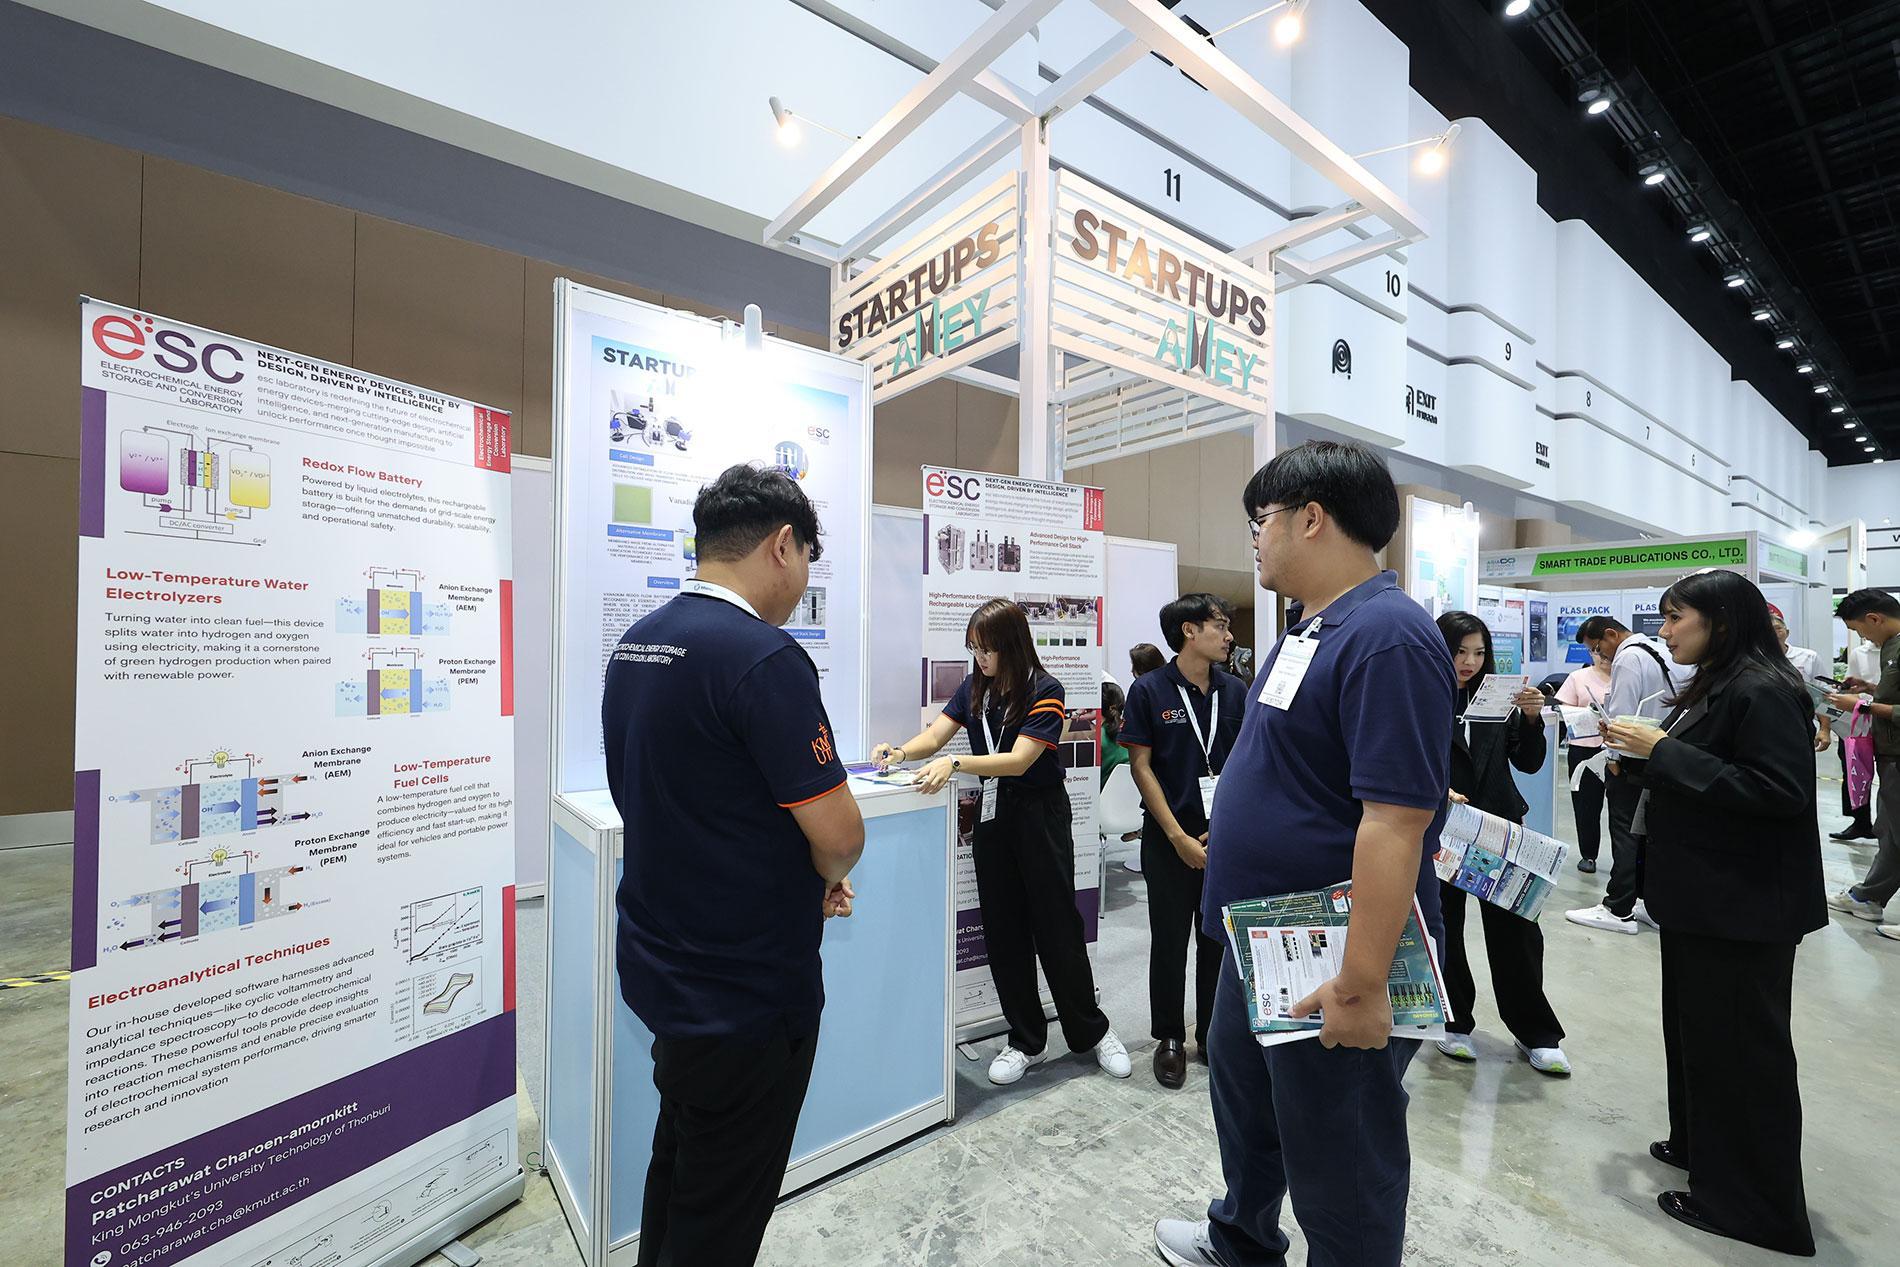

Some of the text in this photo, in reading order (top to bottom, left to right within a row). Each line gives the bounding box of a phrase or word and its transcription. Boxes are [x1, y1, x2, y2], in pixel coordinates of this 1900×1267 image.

[1164, 168, 1181, 201] 11
[1071, 209, 1267, 336] STARTUPS
[838, 223, 1000, 348] STARTUPS
[1385, 270, 1400, 297] 10
[1505, 342, 1512, 361] 9
[603, 347, 696, 378] STARTUP
[100, 360, 242, 397] ELECTROCHEMICAL ENERGY
[258, 350, 459, 409] NEXT-GEN ENERGY DEVICES, BUILT BY
[258, 359, 442, 413] DESIGN, DRIVEN BY INTELLIGENCE
[102, 370, 242, 406] STORAGE AND CONVERSION
[179, 396, 242, 414] LABORATORY
[1416, 390, 1437, 410] EXIT
[1586, 391, 1592, 407] 8
[1646, 426, 1651, 440] 7
[1536, 441, 1549, 457] EXIT
[1692, 454, 1696, 467] 6
[302, 457, 422, 488] Redox Flow Battery
[302, 475, 485, 511] Powered by liquid electrolytes, this rechargeable
[1539, 547, 1742, 569] SMART TRADE PUBLICATIONS CO., LTD.
[106, 567, 308, 590] Low-Temperature Water
[106, 588, 221, 604] Electrolyzers
[448, 594, 484, 602] Membrane
[460, 585, 492, 594] Exchange
[456, 604, 476, 612] (AEM)
[1560, 606, 1609, 614] PLAS&PACK
[105, 612, 150, 624] Turning
[190, 615, 210, 624] into
[214, 616, 242, 625] clean
[245, 617, 290, 626] fuel—this
[293, 619, 323, 627] device
[105, 628, 137, 638] splits
[141, 629, 173, 637] water
[202, 629, 250, 640] hydrogen
[254, 631, 272, 639] and
[275, 633, 309, 641] oxygen
[458, 677, 478, 685] (PEM)
[302, 746, 371, 758] Anion Exchange
[314, 758, 361, 768] Membrane
[394, 755, 490, 773] Low-Temperature
[324, 769, 351, 780] (AEM)
[394, 774, 448, 788] Fuel Cells
[294, 829, 369, 847] Proton Exchange
[309, 842, 357, 856] Membrane
[320, 854, 346, 867] (PEM)
[88, 937, 329, 1009] Electroanalytical Techniques
[86, 948, 374, 1038] Our in-house developed software harnesses advanced
[92, 1102, 357, 1225] Patcharawat Charoen-amornkitt
[90, 1157, 184, 1204] CONTACTS
[92, 1103, 390, 1243] King Mongkut’s University Technology of Thonburi
[120, 1200, 222, 1254] 063-946-2093
